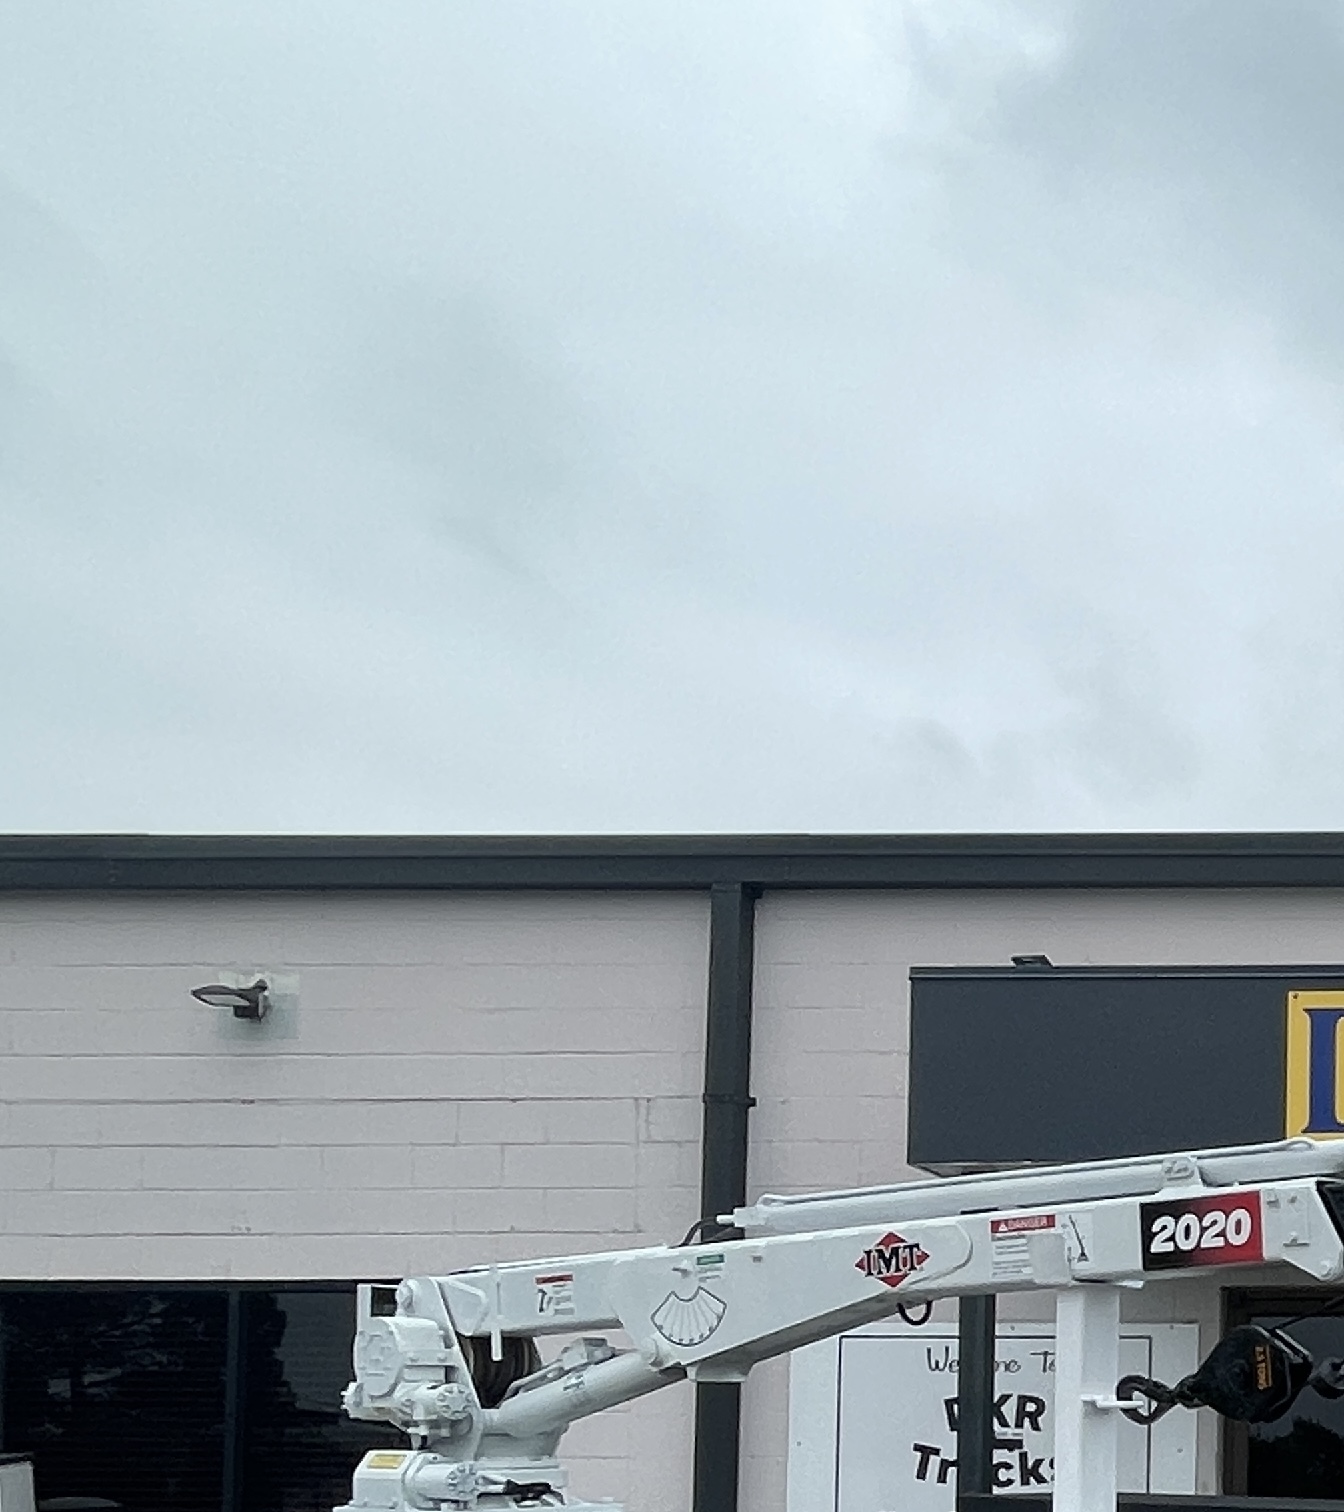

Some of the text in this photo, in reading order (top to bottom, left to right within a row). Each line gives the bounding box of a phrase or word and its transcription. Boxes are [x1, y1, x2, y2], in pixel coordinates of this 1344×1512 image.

[1150, 1208, 1251, 1253] 2020
[863, 1243, 920, 1277] IMT
[913, 1443, 1055, 1487] Trck
